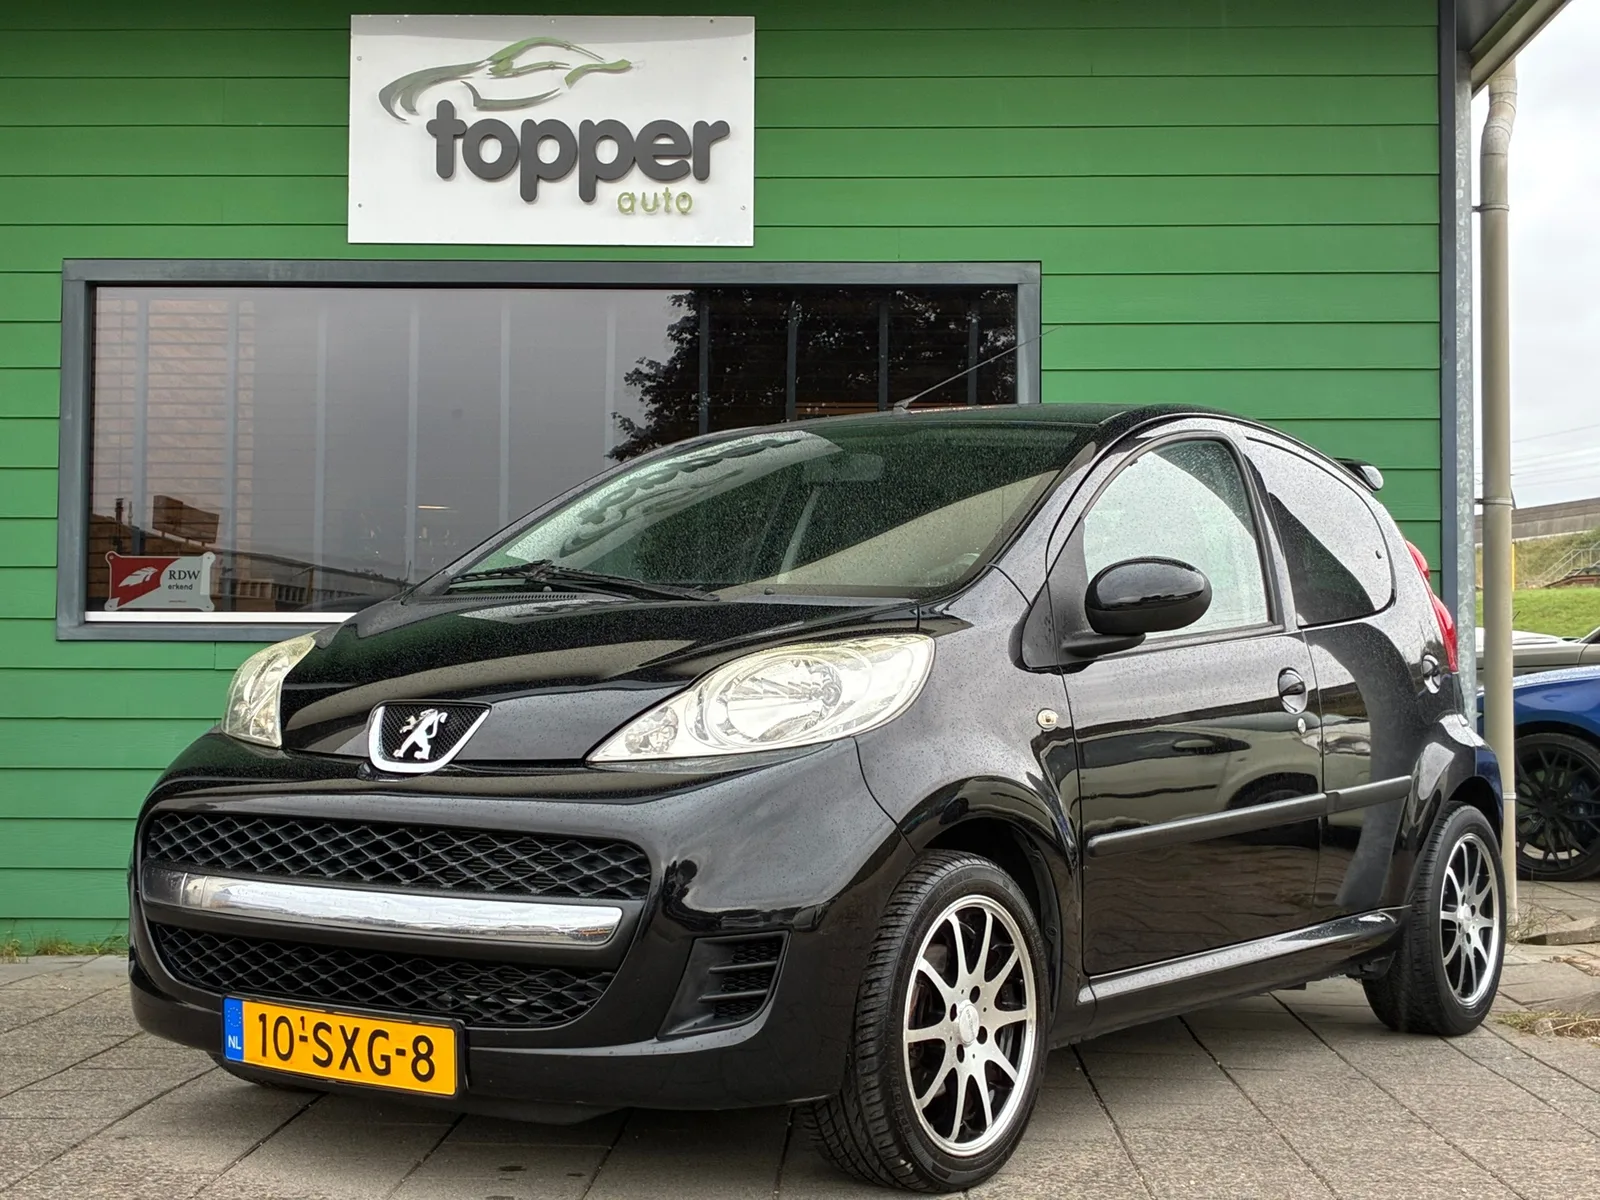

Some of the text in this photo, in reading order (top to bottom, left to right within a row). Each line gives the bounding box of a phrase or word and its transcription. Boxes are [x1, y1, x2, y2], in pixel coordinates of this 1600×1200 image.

[426, 99, 730, 203] topper
[617, 187, 693, 215] auto
[168, 570, 200, 580] RDW
[228, 1034, 241, 1050] NL
